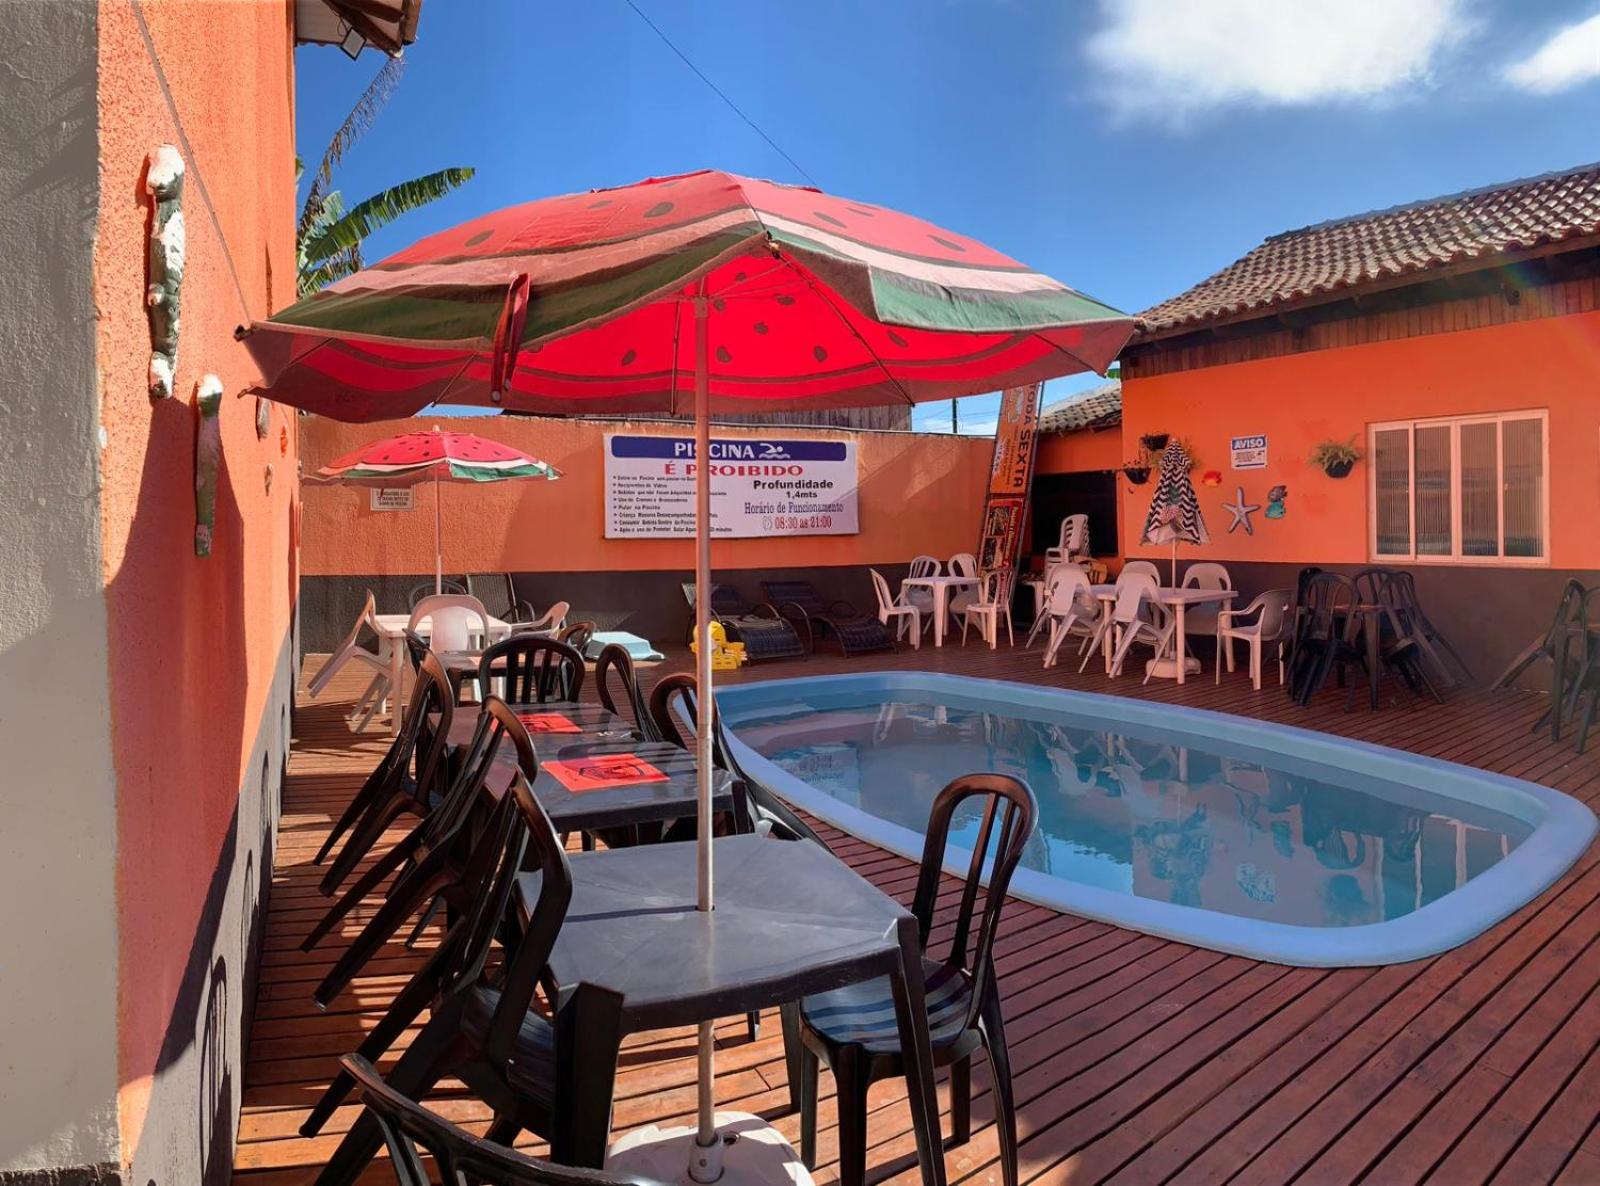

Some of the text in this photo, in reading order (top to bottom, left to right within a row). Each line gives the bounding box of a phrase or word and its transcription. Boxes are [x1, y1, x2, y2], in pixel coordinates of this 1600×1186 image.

[1024, 384, 1037, 425] TODA
[675, 442, 755, 459] PICINA
[1234, 438, 1264, 449] AVISO
[1013, 429, 1032, 488] SEXTA
[665, 460, 675, 475] É
[753, 480, 834, 490] Profundidade
[786, 491, 818, 500] 1,4mts
[745, 501, 844, 514] Horário de Funcionamento
[775, 516, 798, 530] 08:30
[810, 515, 833, 529] 21:00
